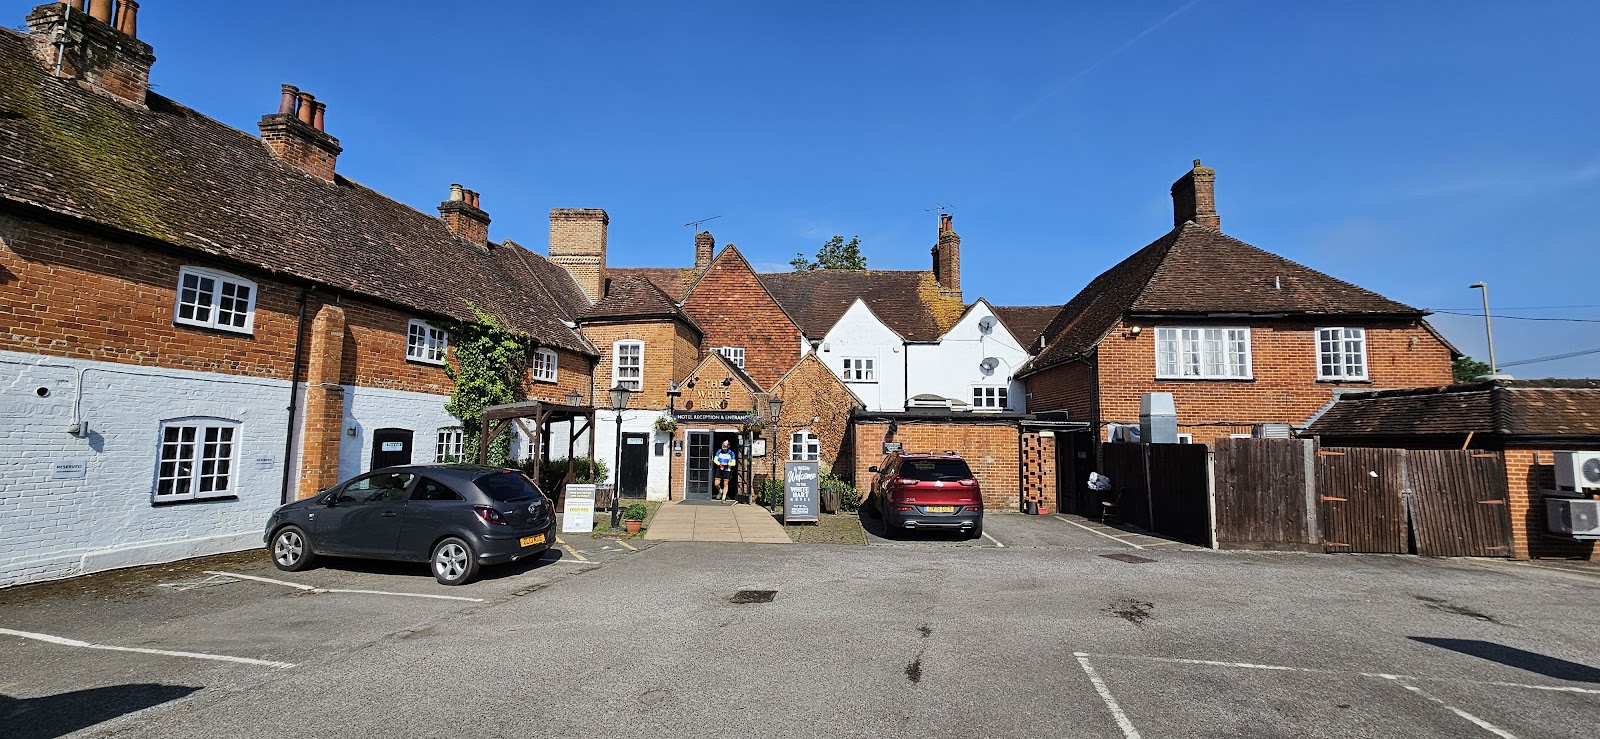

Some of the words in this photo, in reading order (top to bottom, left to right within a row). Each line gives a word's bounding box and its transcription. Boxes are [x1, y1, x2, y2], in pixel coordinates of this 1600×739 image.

[704, 379, 724, 388] THE
[698, 390, 730, 399] WHITE
[701, 400, 728, 409] HART
[787, 466, 817, 483] Welcome
